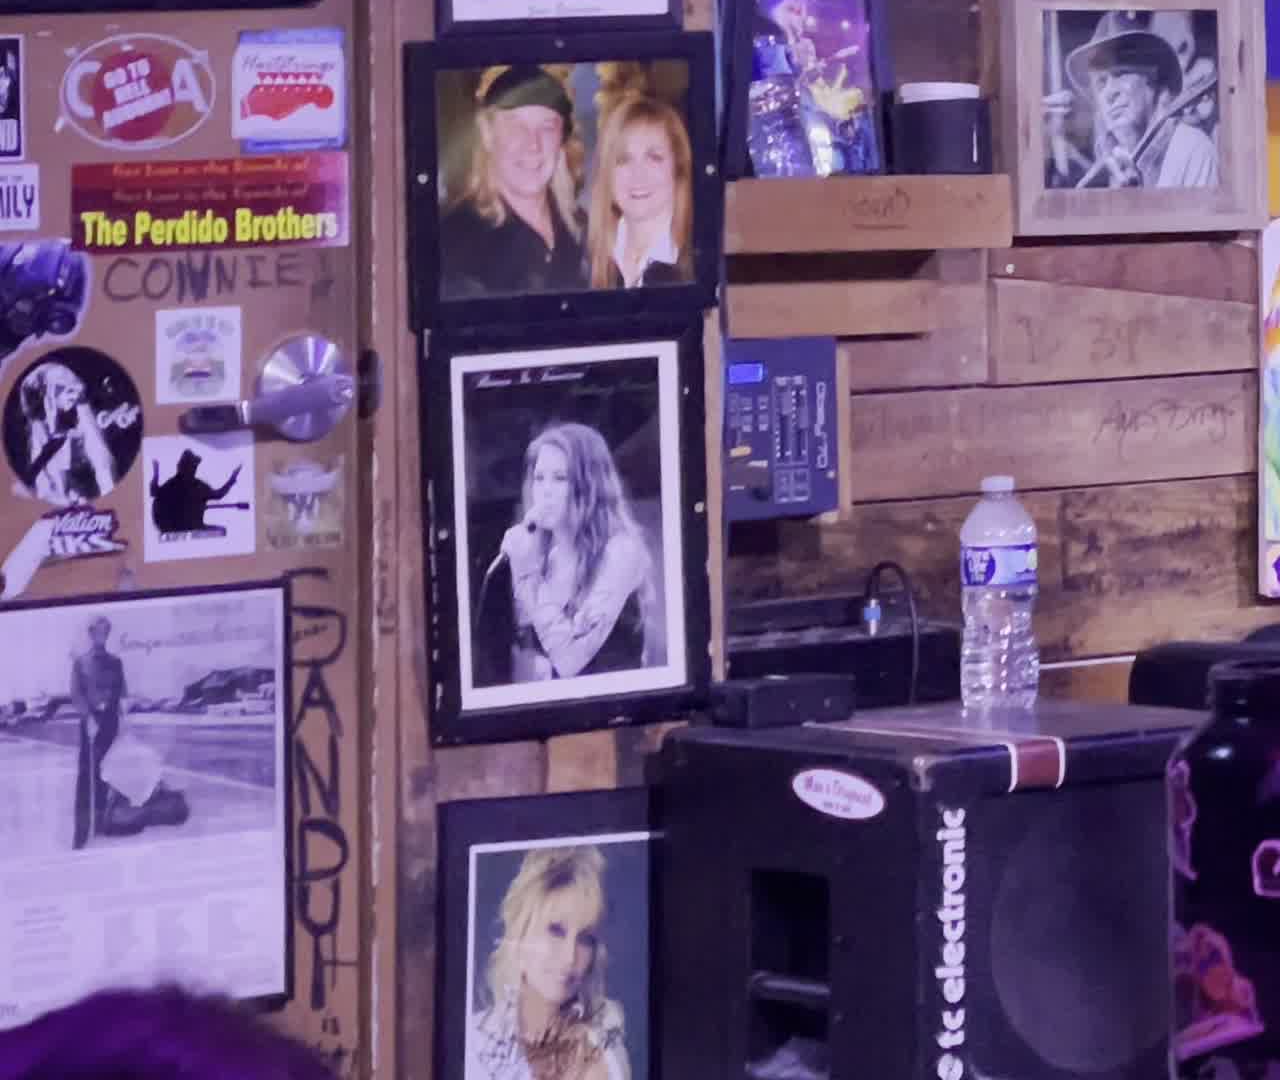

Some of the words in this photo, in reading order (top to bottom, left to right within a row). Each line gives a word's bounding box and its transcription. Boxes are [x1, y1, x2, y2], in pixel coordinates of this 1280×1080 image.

[80, 211, 128, 247] The
[134, 209, 228, 246] Perdido
[235, 205, 338, 242] Brothers
[935, 807, 966, 1004] electronic
[936, 1007, 966, 1050] tc
